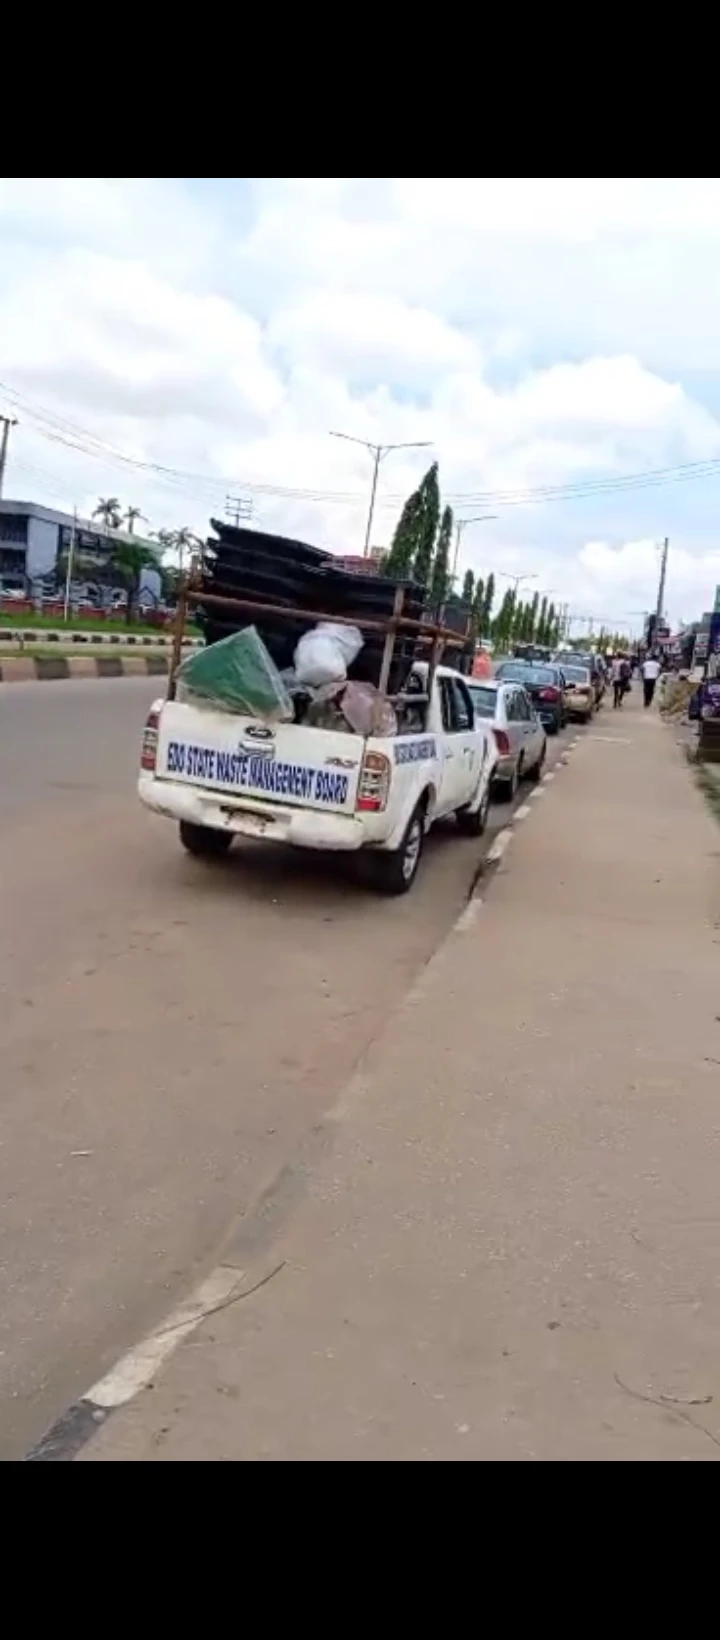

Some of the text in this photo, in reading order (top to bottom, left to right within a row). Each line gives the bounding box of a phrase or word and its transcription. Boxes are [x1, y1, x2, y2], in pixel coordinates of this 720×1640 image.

[168, 742, 348, 804] EDO STATE WASTE MANAGEMENT BOARD
